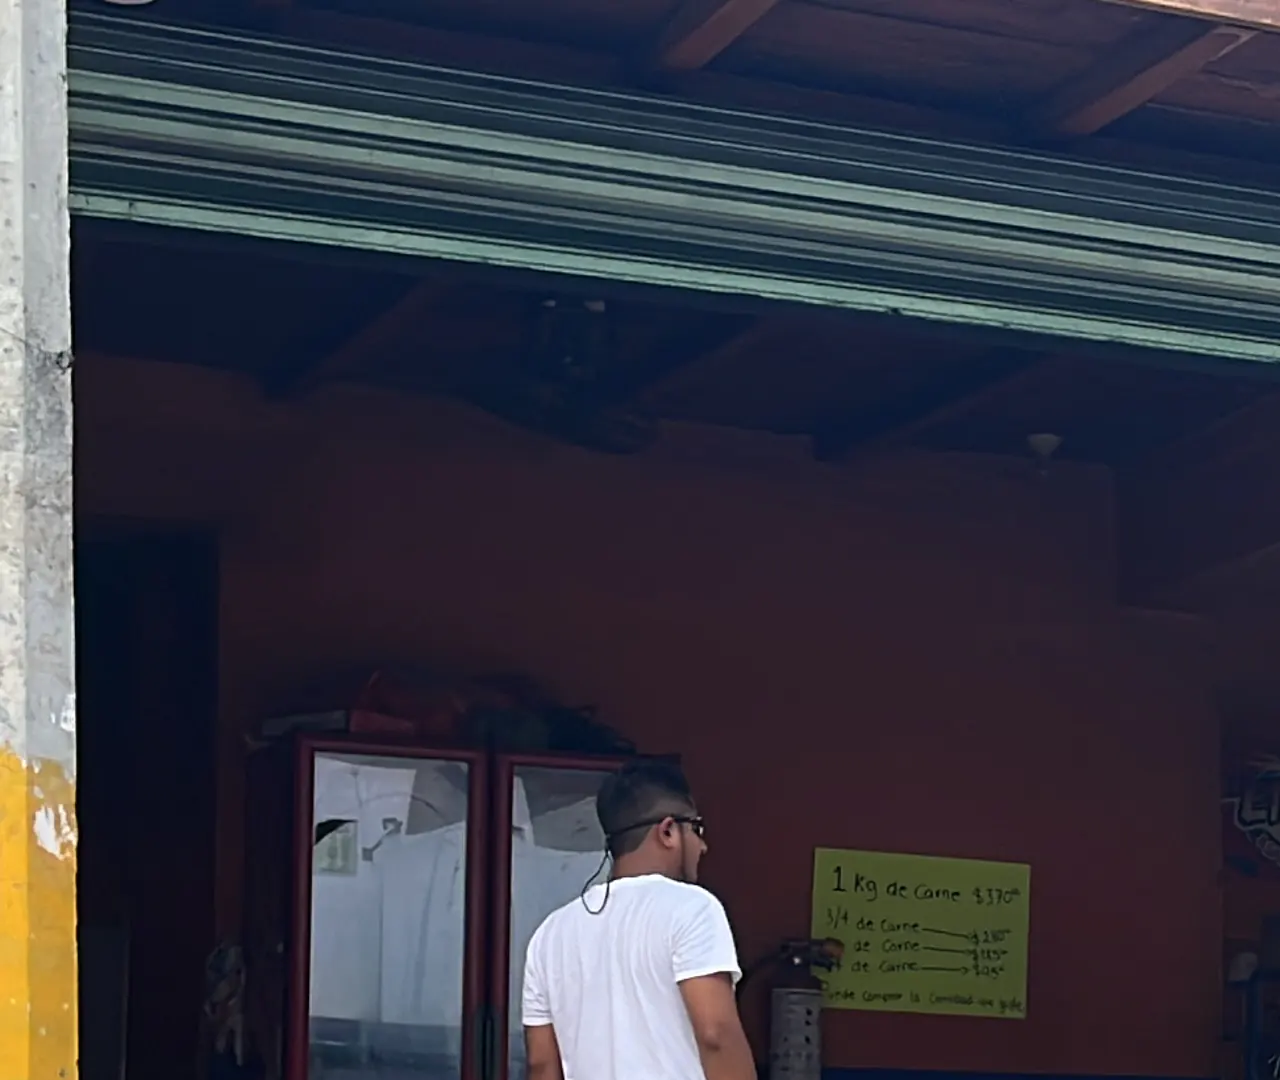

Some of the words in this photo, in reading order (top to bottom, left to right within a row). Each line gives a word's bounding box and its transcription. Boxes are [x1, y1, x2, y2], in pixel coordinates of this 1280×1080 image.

[832, 865, 847, 892] 1
[854, 872, 878, 901] Kg
[886, 881, 908, 900] de
[914, 884, 961, 902] Carne
[856, 916, 876, 932] de
[881, 918, 921, 933] Carne
[854, 939, 871, 952] de
[881, 938, 921, 953] Carne
[851, 961, 870, 973] de
[878, 959, 919, 973] Carne
